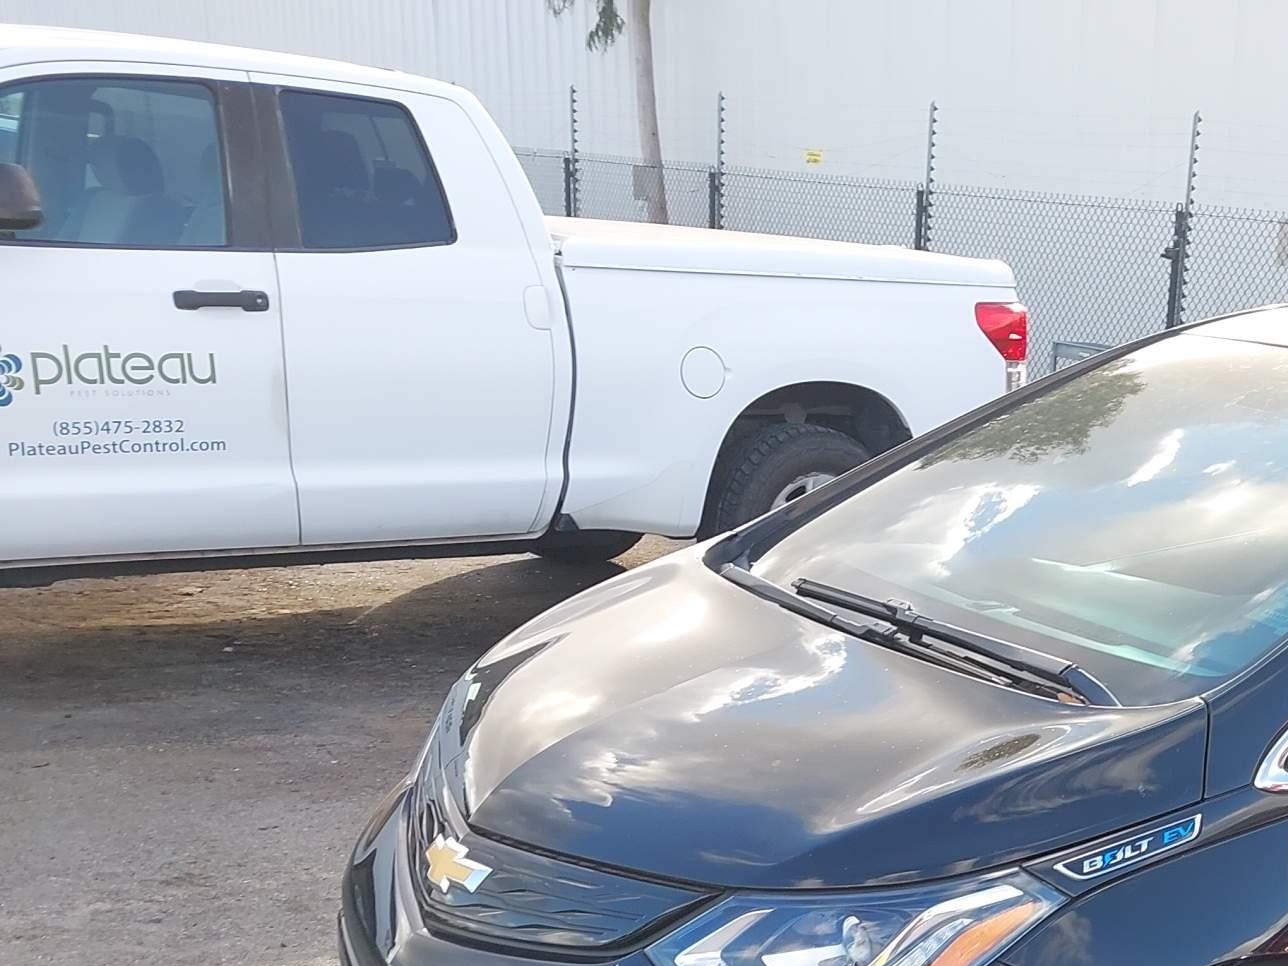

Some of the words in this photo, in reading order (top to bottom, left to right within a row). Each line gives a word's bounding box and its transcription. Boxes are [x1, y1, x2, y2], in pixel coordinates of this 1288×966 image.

[30, 344, 217, 395] plateau
[52, 419, 185, 437] (855)475-2832
[8, 438, 227, 457] PlateauPestControl.com
[1082, 837, 1154, 874] BOLT
[1162, 821, 1195, 844] EV
